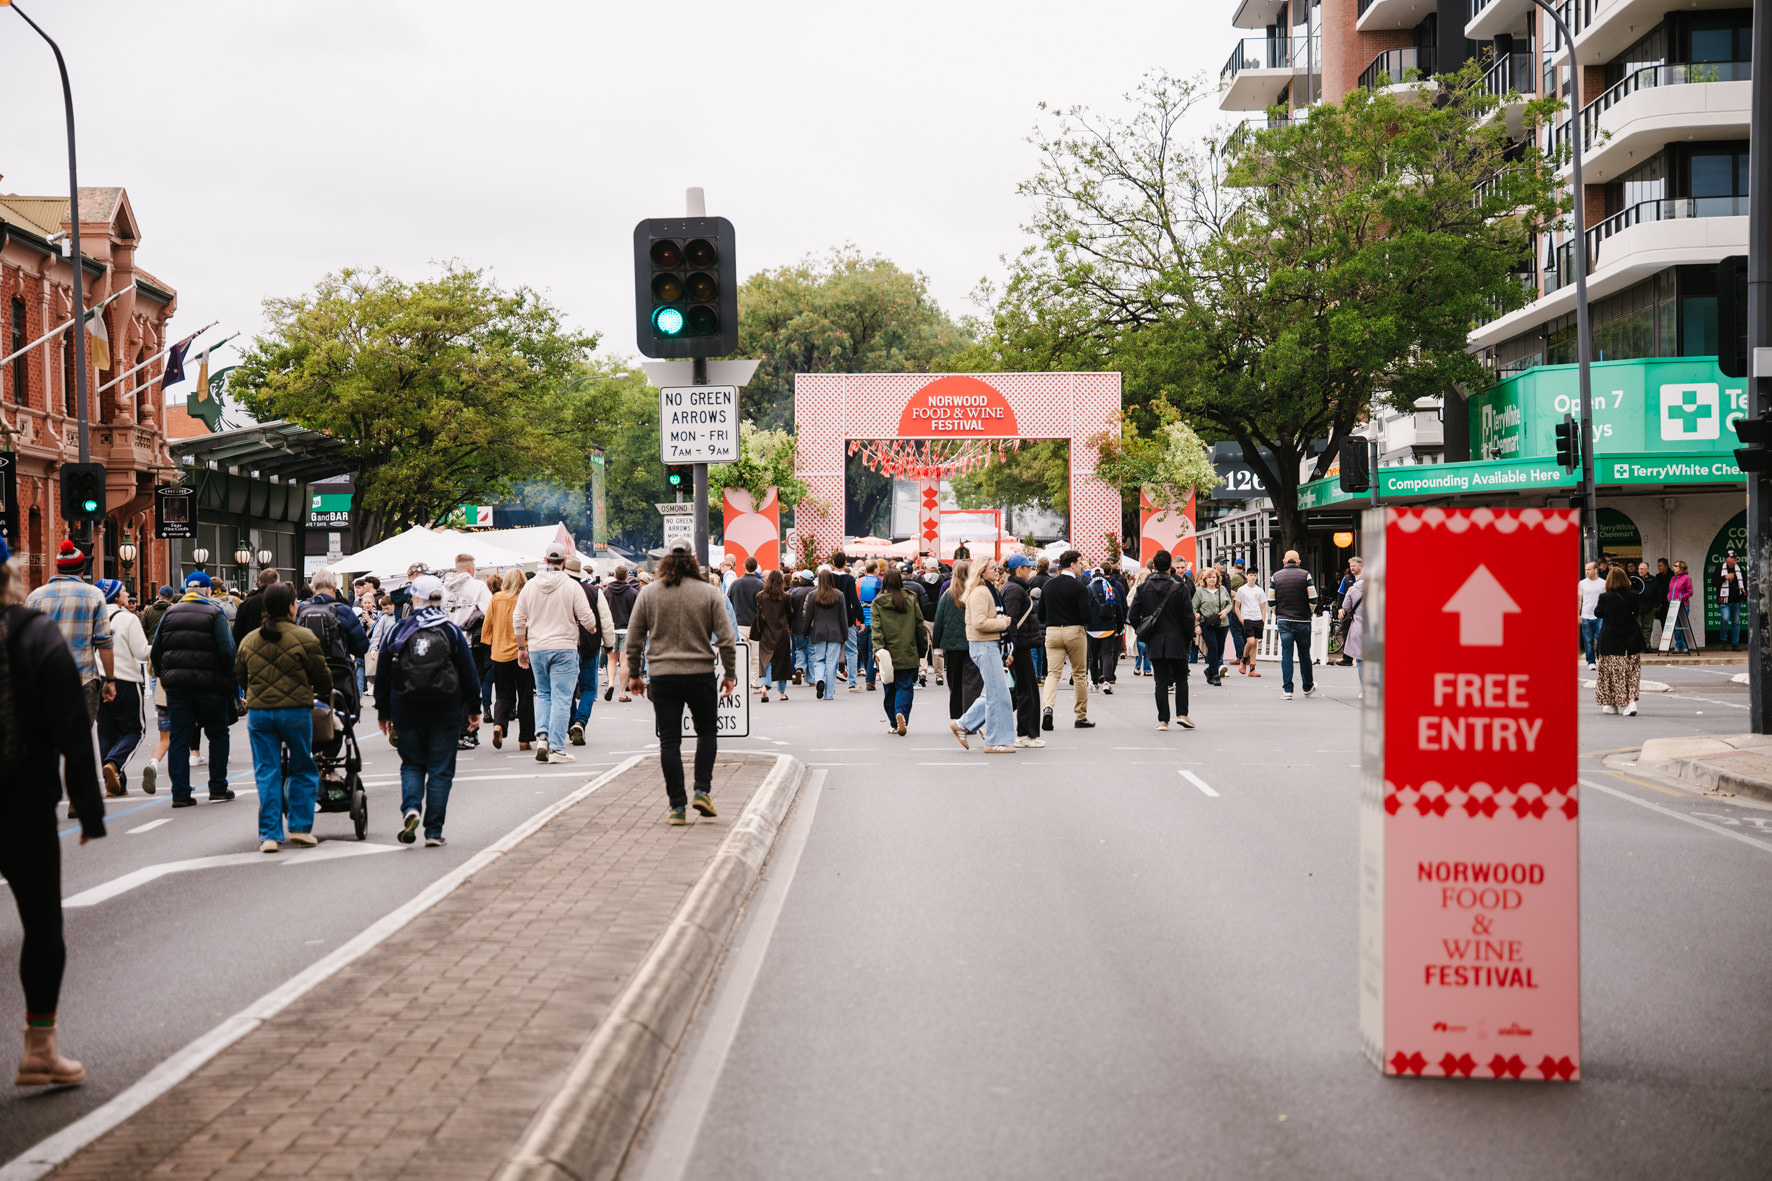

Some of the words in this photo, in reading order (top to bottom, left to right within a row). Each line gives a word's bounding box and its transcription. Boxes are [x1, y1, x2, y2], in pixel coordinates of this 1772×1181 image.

[666, 393, 682, 406] NO
[690, 392, 731, 405] GREEN
[928, 396, 988, 406] NORWOOD
[1554, 394, 1606, 416] Opn
[1611, 390, 1624, 408] 7
[1725, 389, 1748, 409] Te
[672, 410, 726, 424] ARROWS
[912, 407, 950, 419] FOOD
[953, 407, 965, 419] &
[966, 407, 1005, 418] WINE
[1493, 403, 1520, 435] TerryWhite
[671, 431, 696, 441] MON
[709, 430, 728, 440] FRI
[931, 420, 984, 430] FESTIVAL
[670, 446, 692, 456] 7AM
[708, 444, 729, 455] 9AM
[1388, 475, 1469, 492] Compounding
[1472, 469, 1527, 485] Available
[1530, 468, 1560, 481] Here
[1632, 464, 1709, 479] TerryWhite
[1600, 523, 1635, 533] TerryWhite
[1433, 672, 1530, 708] FREE
[1418, 716, 1543, 751] ENTRY
[1417, 861, 1545, 885] NORWOOD
[1442, 887, 1523, 911] FOOD
[1471, 913, 1494, 936] &
[1442, 939, 1523, 963] WINE
[1424, 964, 1540, 989] FESTIVAL
